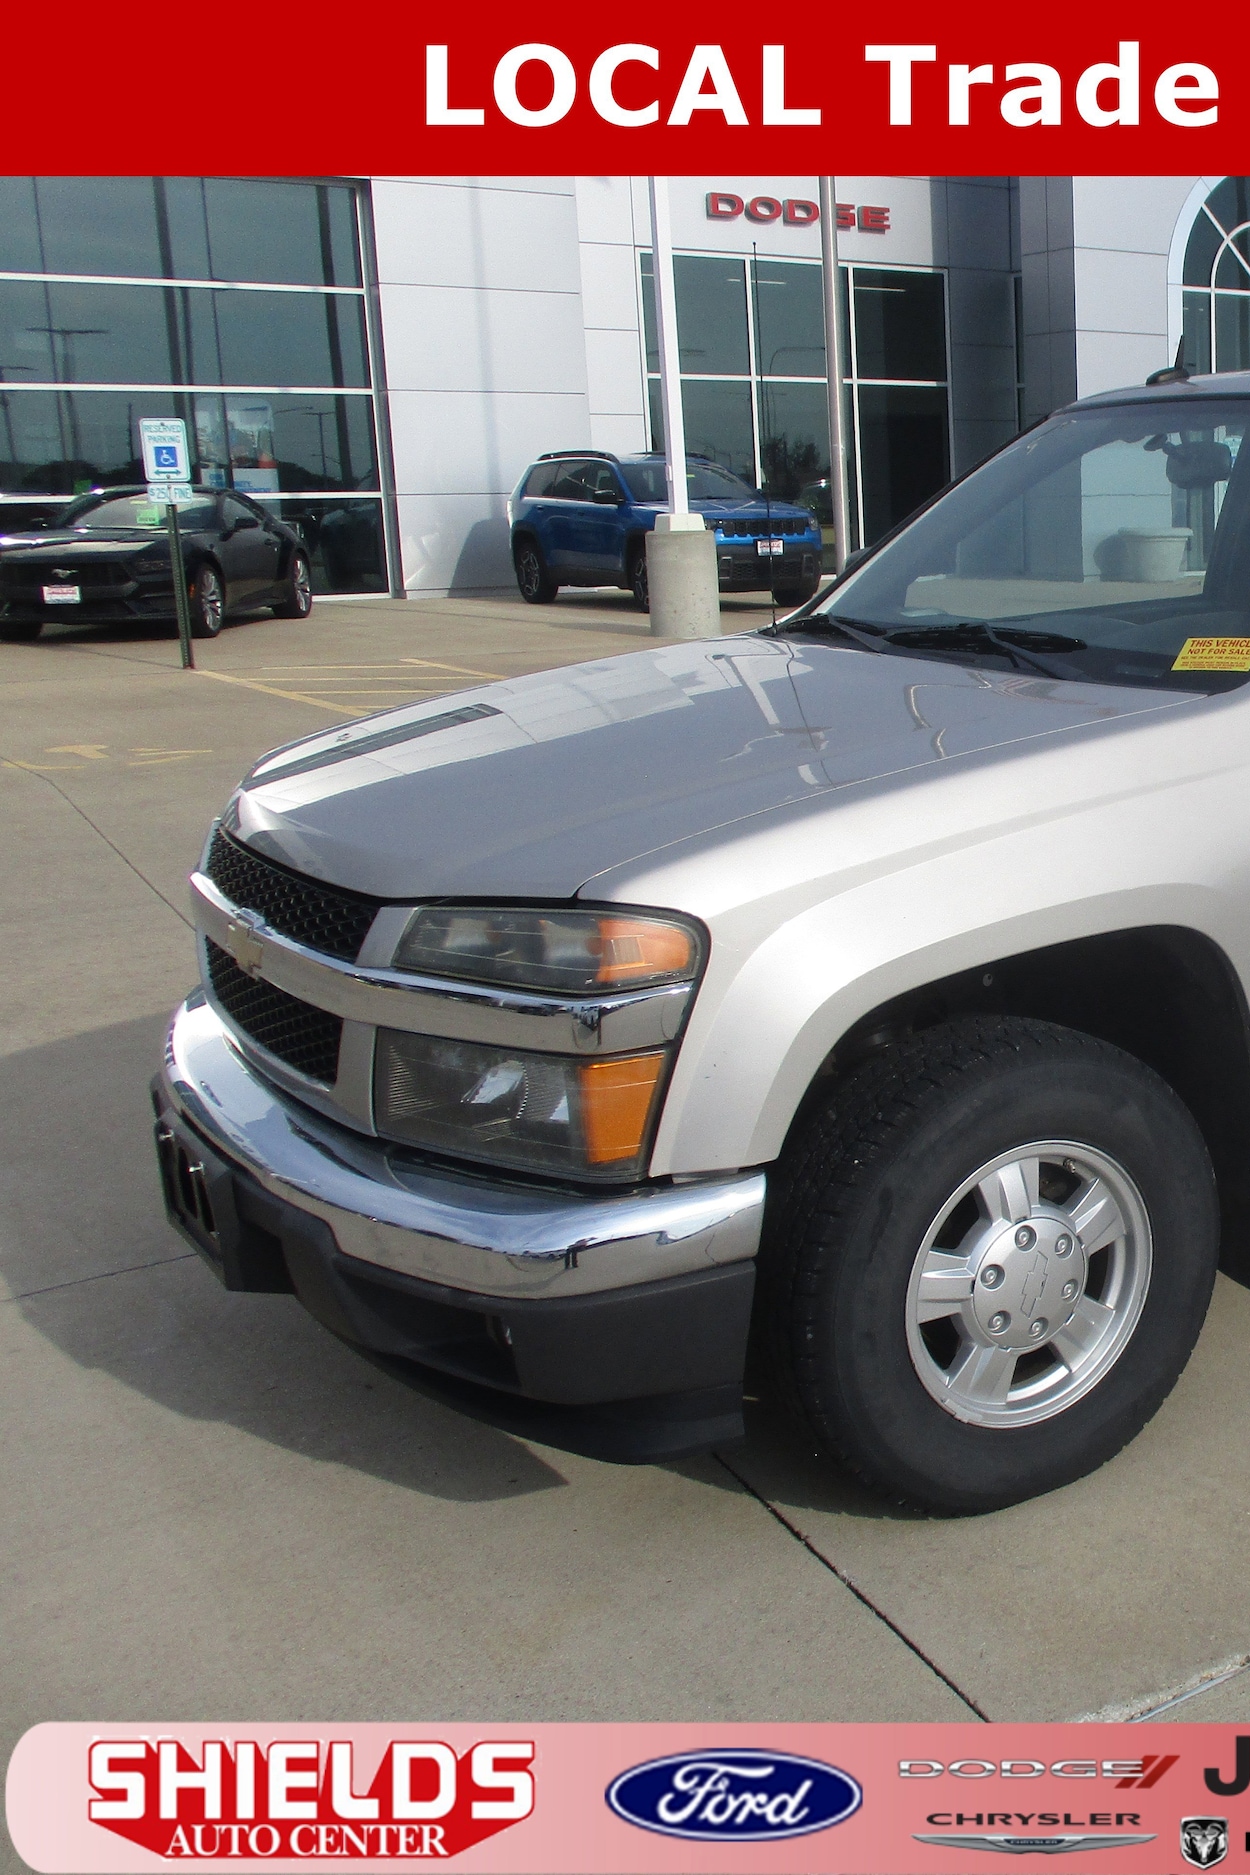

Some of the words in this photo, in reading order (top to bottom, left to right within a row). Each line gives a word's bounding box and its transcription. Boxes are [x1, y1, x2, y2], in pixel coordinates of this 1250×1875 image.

[706, 191, 891, 233] DODGE
[142, 424, 182, 433] RESERVED
[147, 435, 181, 443] PARKING
[173, 487, 191, 499] FINE
[1190, 639, 1213, 648] THIS
